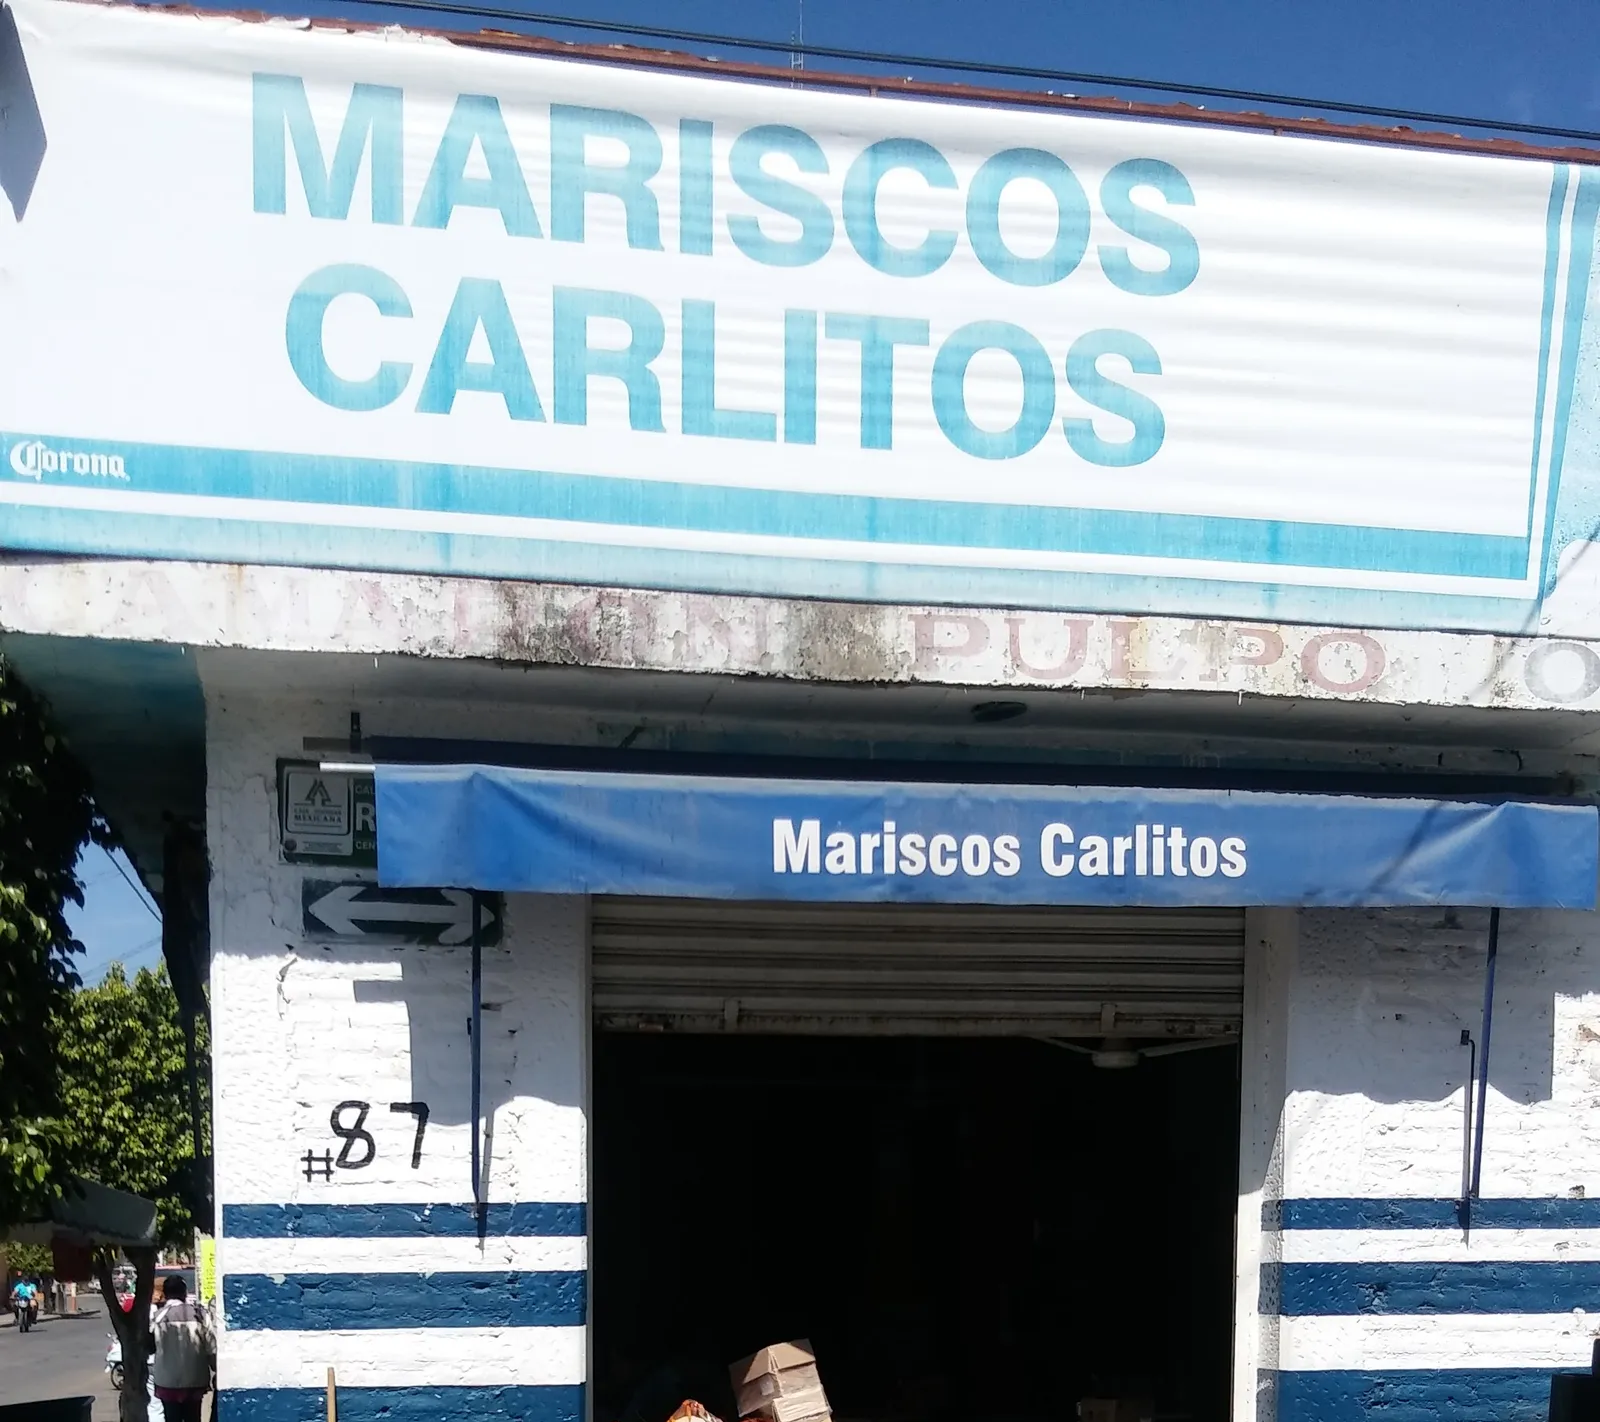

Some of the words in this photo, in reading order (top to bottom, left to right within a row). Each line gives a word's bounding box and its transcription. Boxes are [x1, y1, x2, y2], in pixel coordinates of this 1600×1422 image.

[252, 72, 1200, 297] MARISCOS
[285, 262, 1166, 467] CARLITOS
[9, 440, 126, 481] Corona
[907, 612, 1386, 694] PULPO
[772, 818, 1021, 877] Mariscos
[1039, 821, 1248, 878] Carlitos
[300, 1100, 430, 1182] #87
